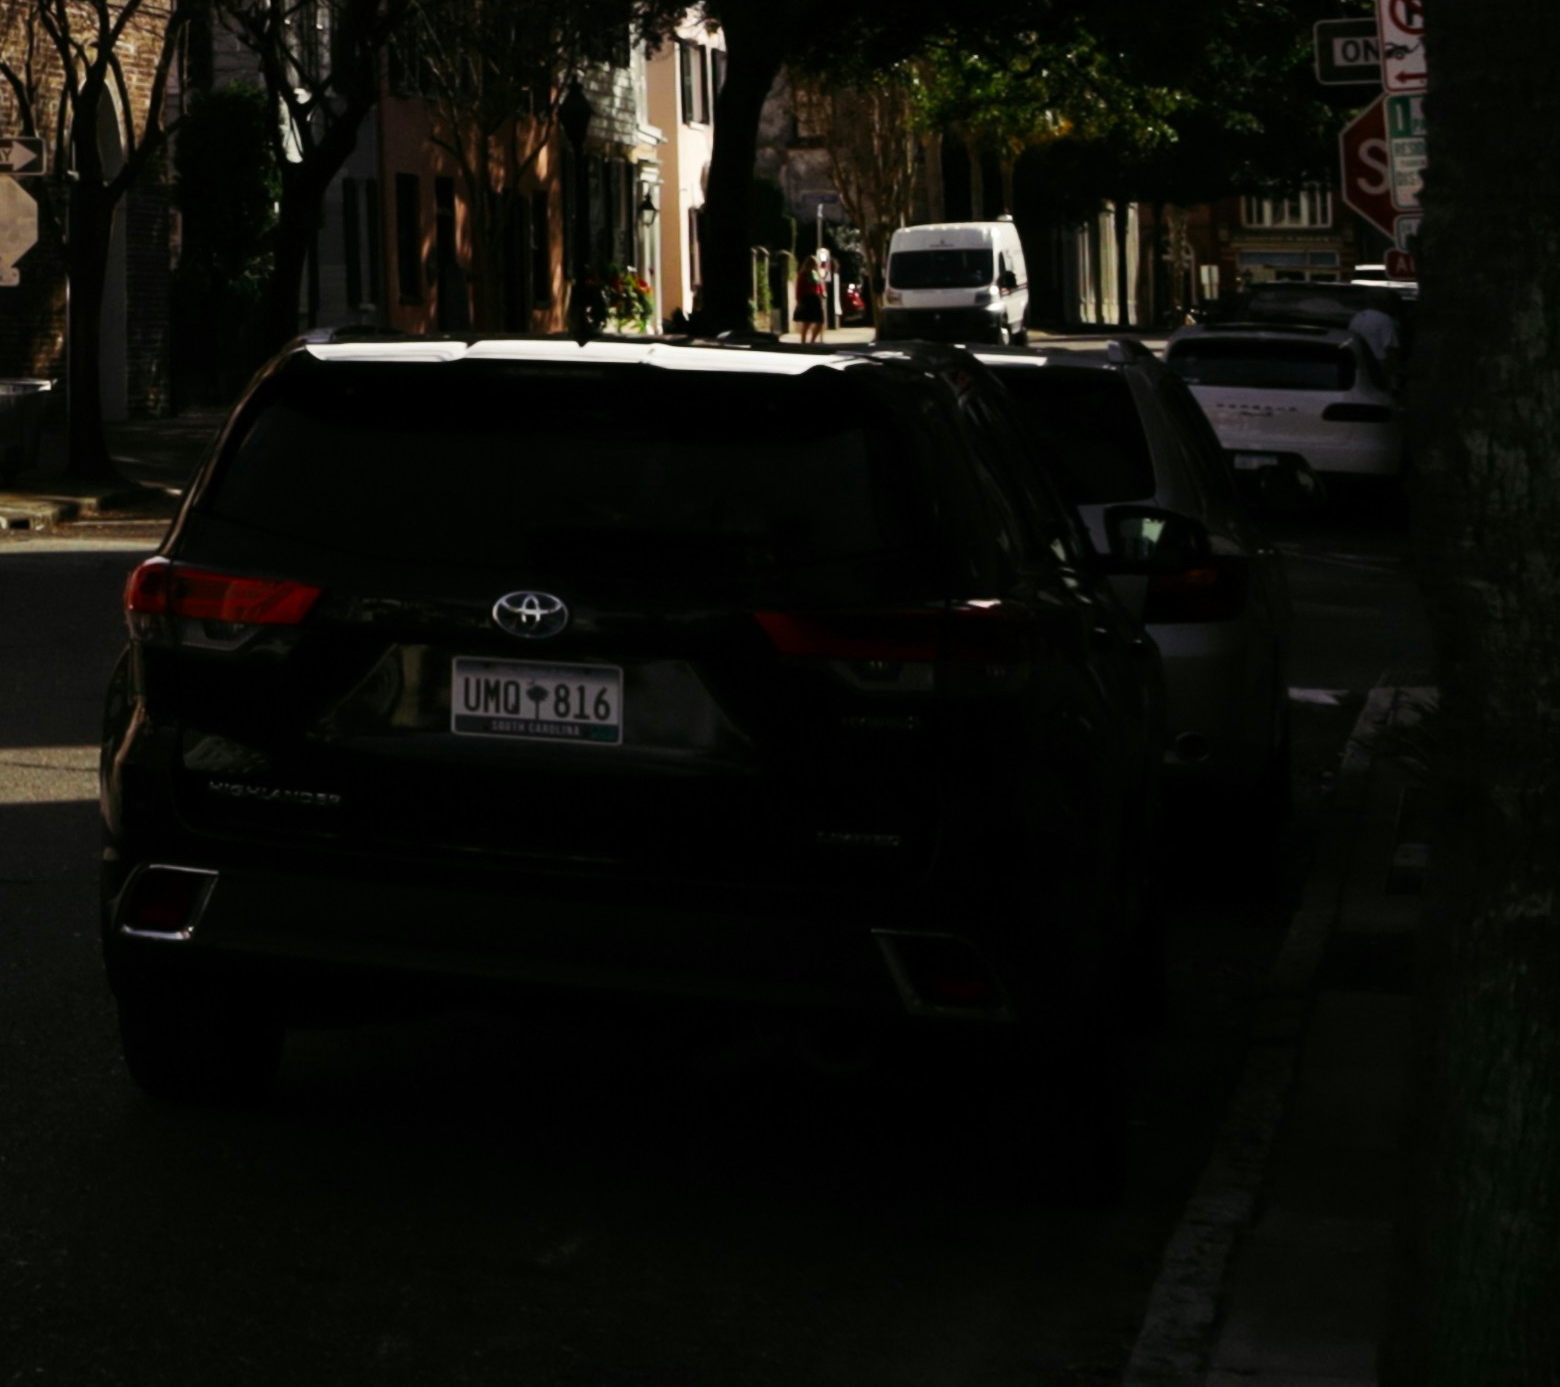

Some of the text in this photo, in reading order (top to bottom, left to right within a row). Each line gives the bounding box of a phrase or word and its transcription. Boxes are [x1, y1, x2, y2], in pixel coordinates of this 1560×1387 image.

[1341, 39, 1380, 63] ON
[464, 677, 611, 721] UMQ 816
[490, 719, 581, 737] SOUTH CAROLINA
